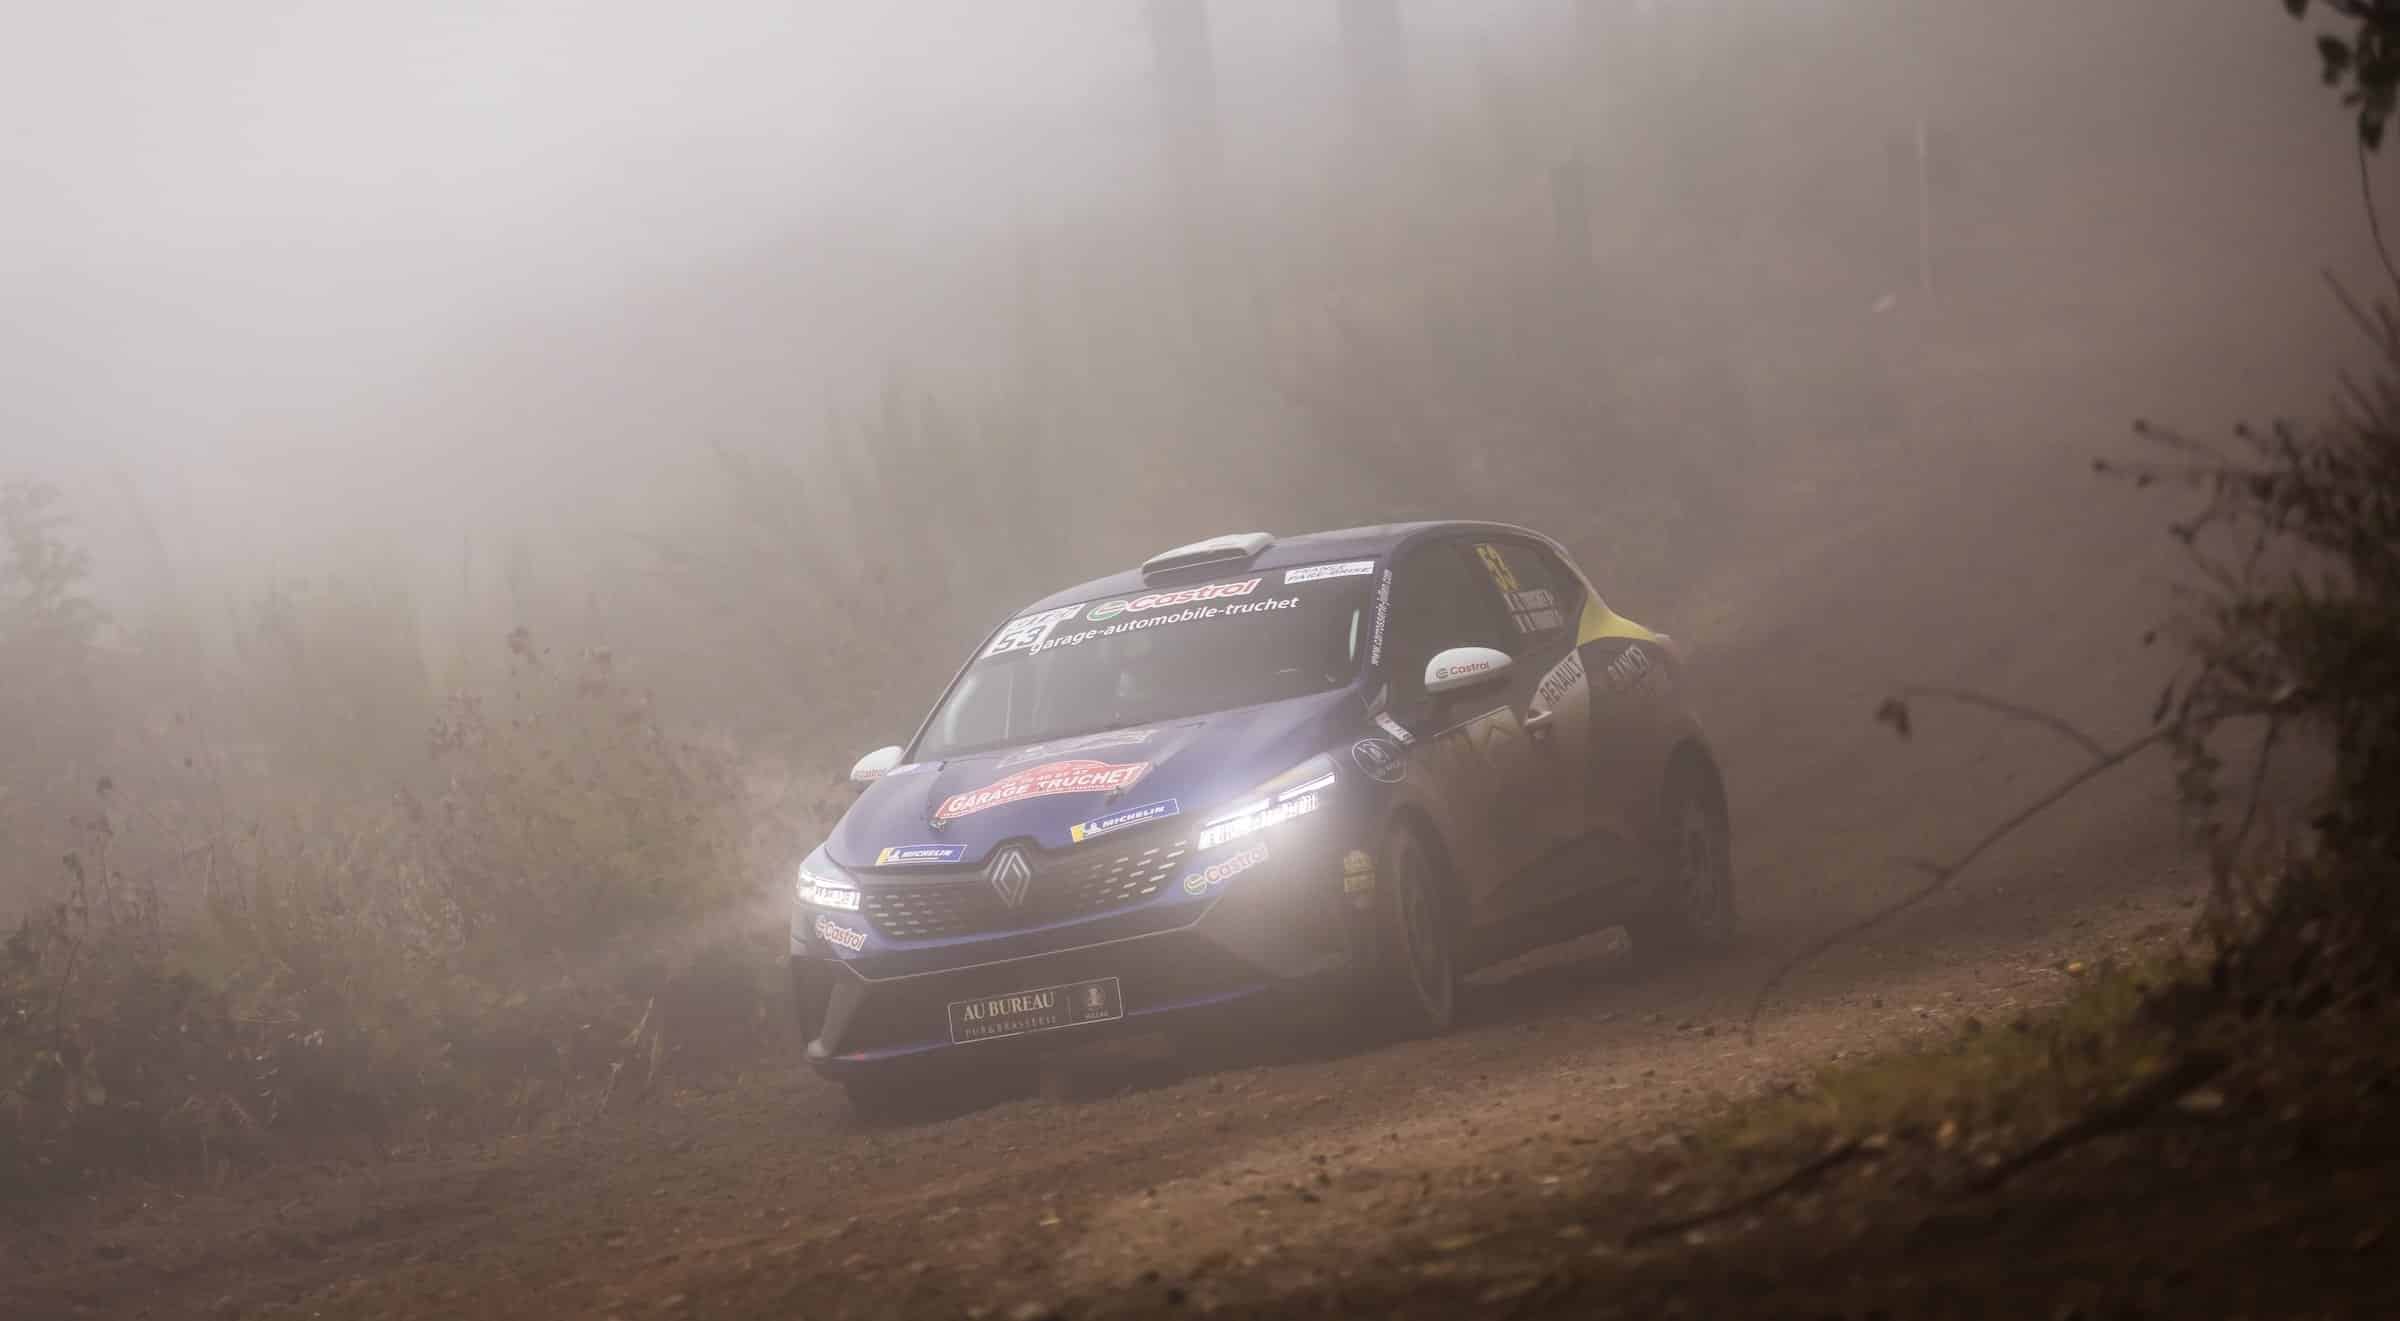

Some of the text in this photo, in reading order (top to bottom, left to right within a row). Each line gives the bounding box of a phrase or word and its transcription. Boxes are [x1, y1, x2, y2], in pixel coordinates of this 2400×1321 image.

[1126, 578, 1262, 612] Castrol
[991, 628, 1043, 652] 53
[1029, 597, 1300, 655] garage-automobile-truchet
[1450, 662, 1489, 675] Castrol
[1540, 655, 1584, 704] RENAULT
[950, 784, 1032, 813] GARAGE
[1037, 767, 1138, 791] TRUCHET
[1102, 805, 1165, 828] MICHELIN
[901, 849, 952, 858] MICHELIN
[1206, 844, 1268, 883] Castrol
[825, 920, 867, 951] Castrol
[963, 991, 1057, 1022] AU BUREAU
